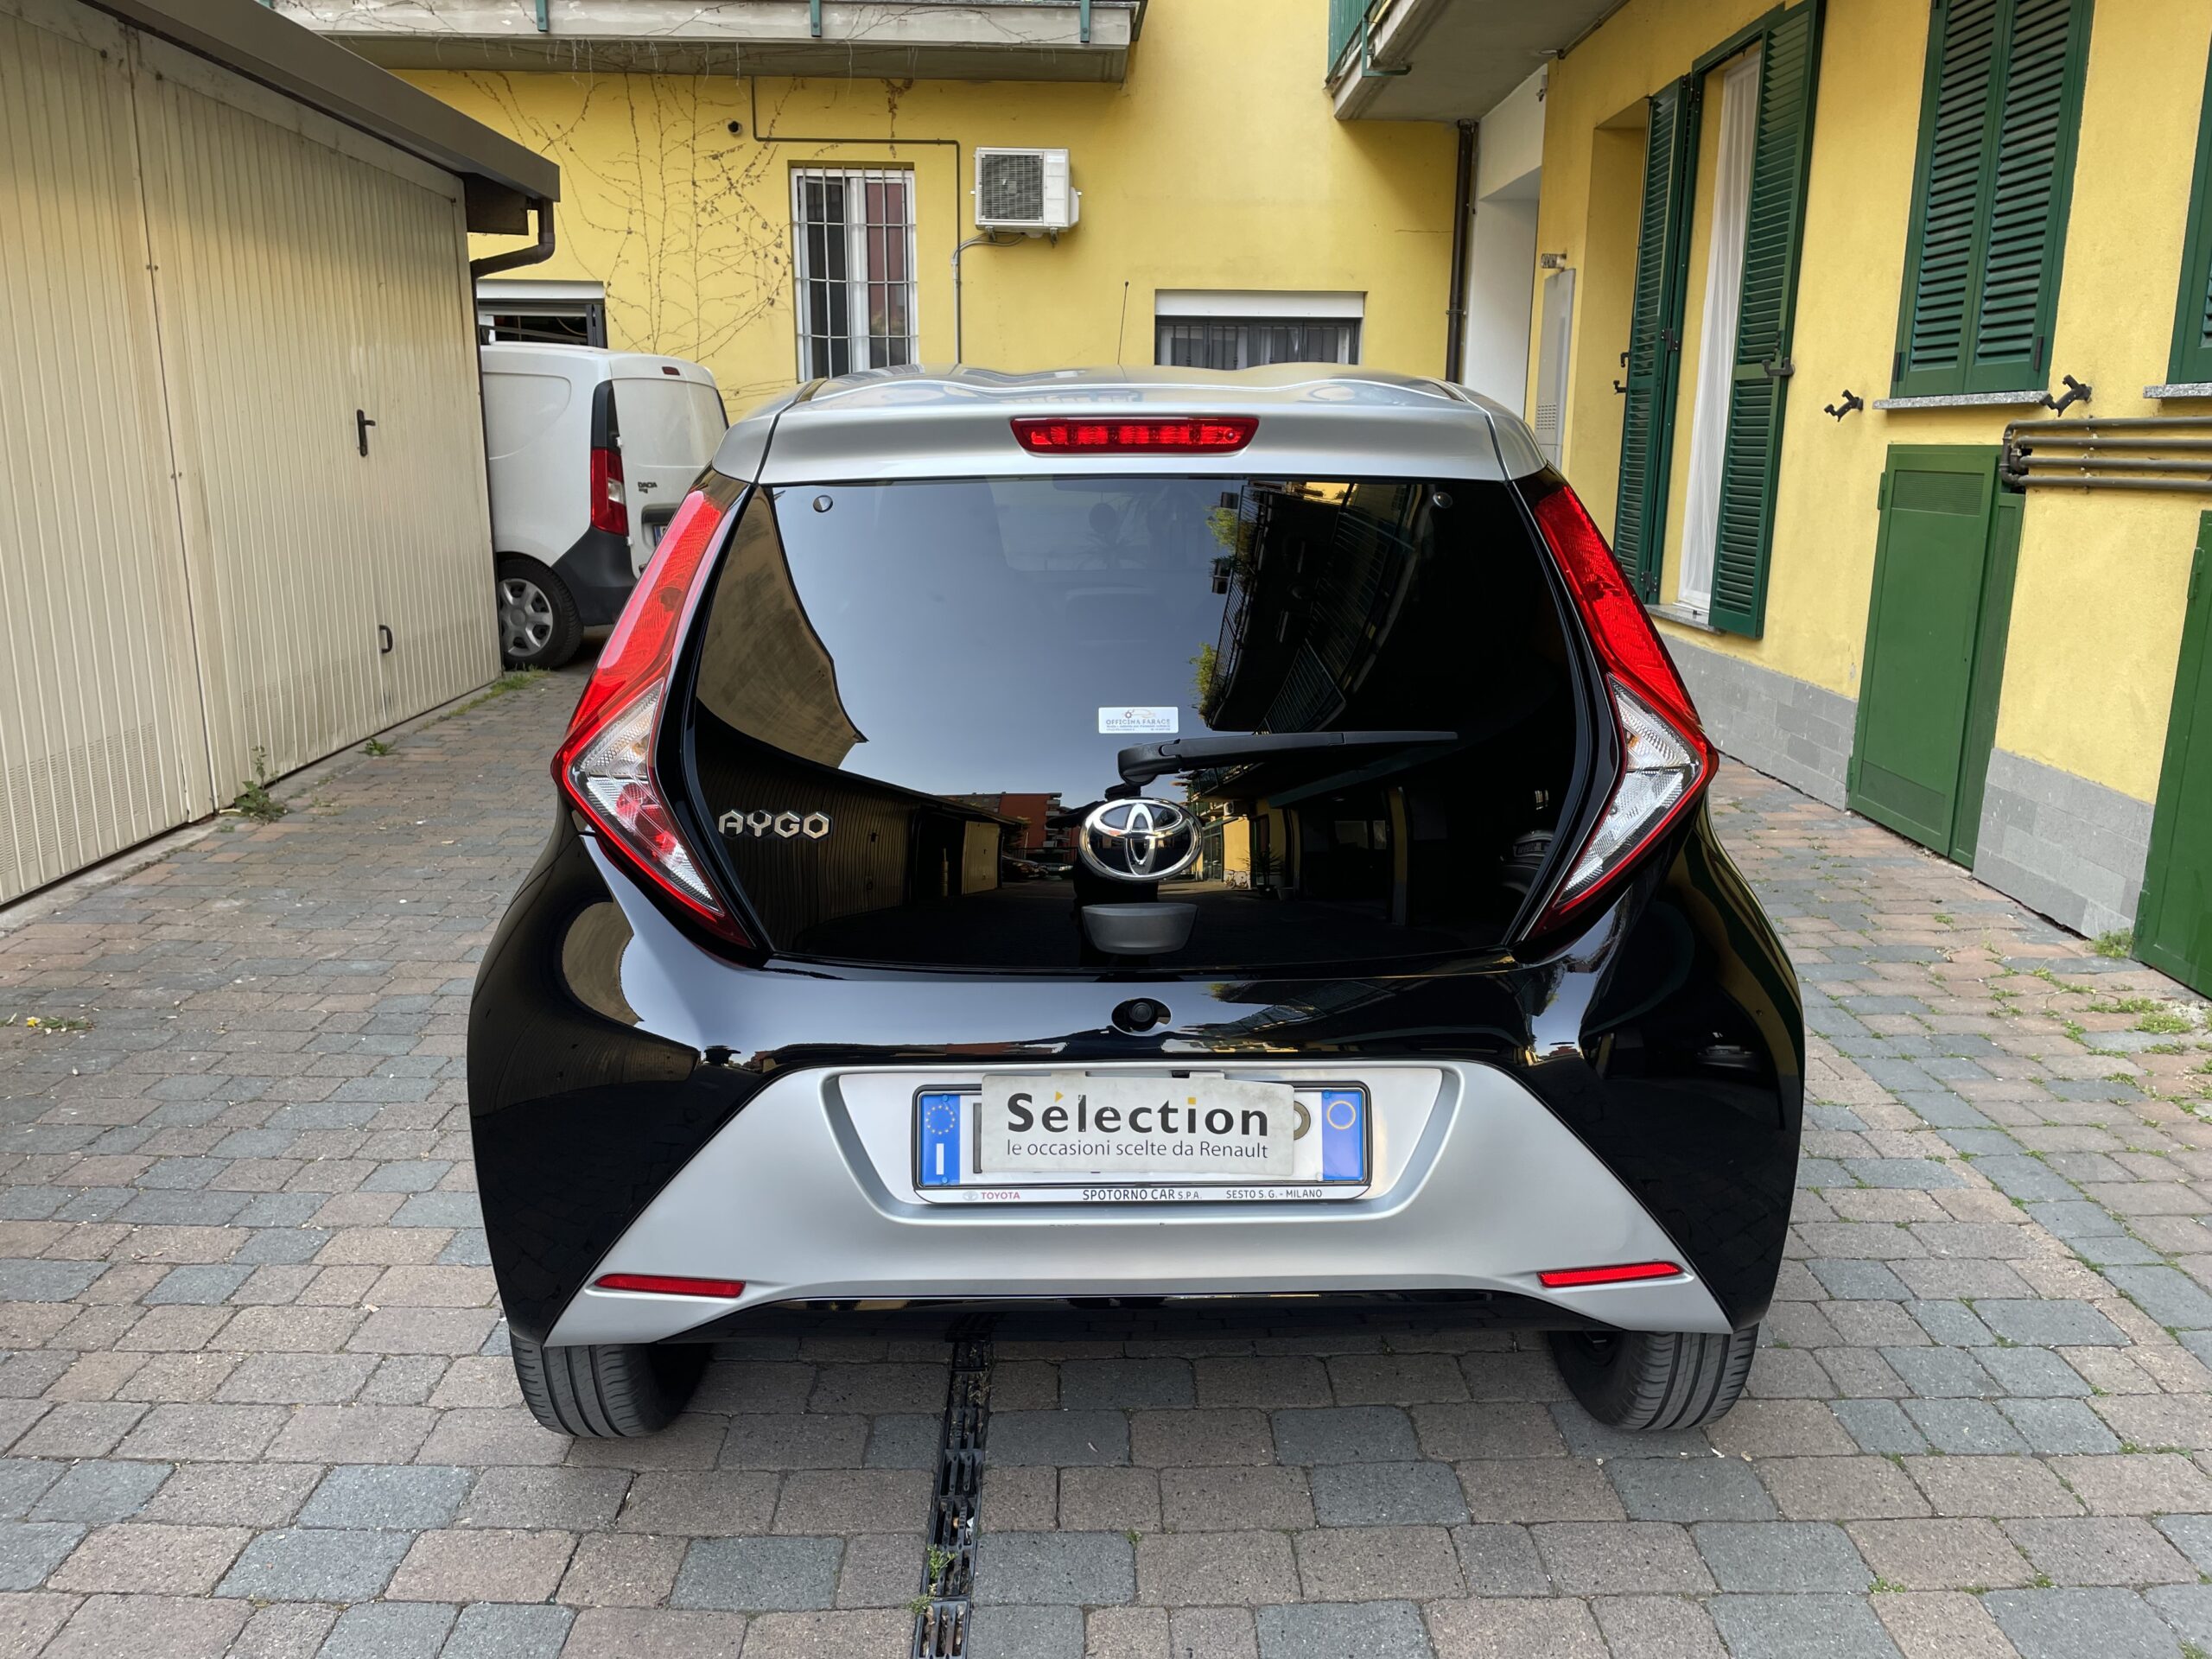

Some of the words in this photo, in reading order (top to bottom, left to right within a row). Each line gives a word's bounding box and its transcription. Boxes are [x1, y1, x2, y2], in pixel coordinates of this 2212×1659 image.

[718, 810, 830, 839] AYGO
[1007, 1090, 1268, 1136] Sélection
[1007, 1139, 1022, 1155] le
[1027, 1140, 1110, 1155] occasioni
[1116, 1140, 1166, 1156] scelte
[1172, 1140, 1193, 1156] da
[1200, 1141, 1268, 1158] Renault
[981, 1192, 1020, 1200] TOYOTA
[1083, 1189, 1147, 1201] SPOTORNO
[1151, 1189, 1175, 1200] CAR
[1226, 1189, 1256, 1199] SESTO
[1286, 1189, 1323, 1198] MILANO
